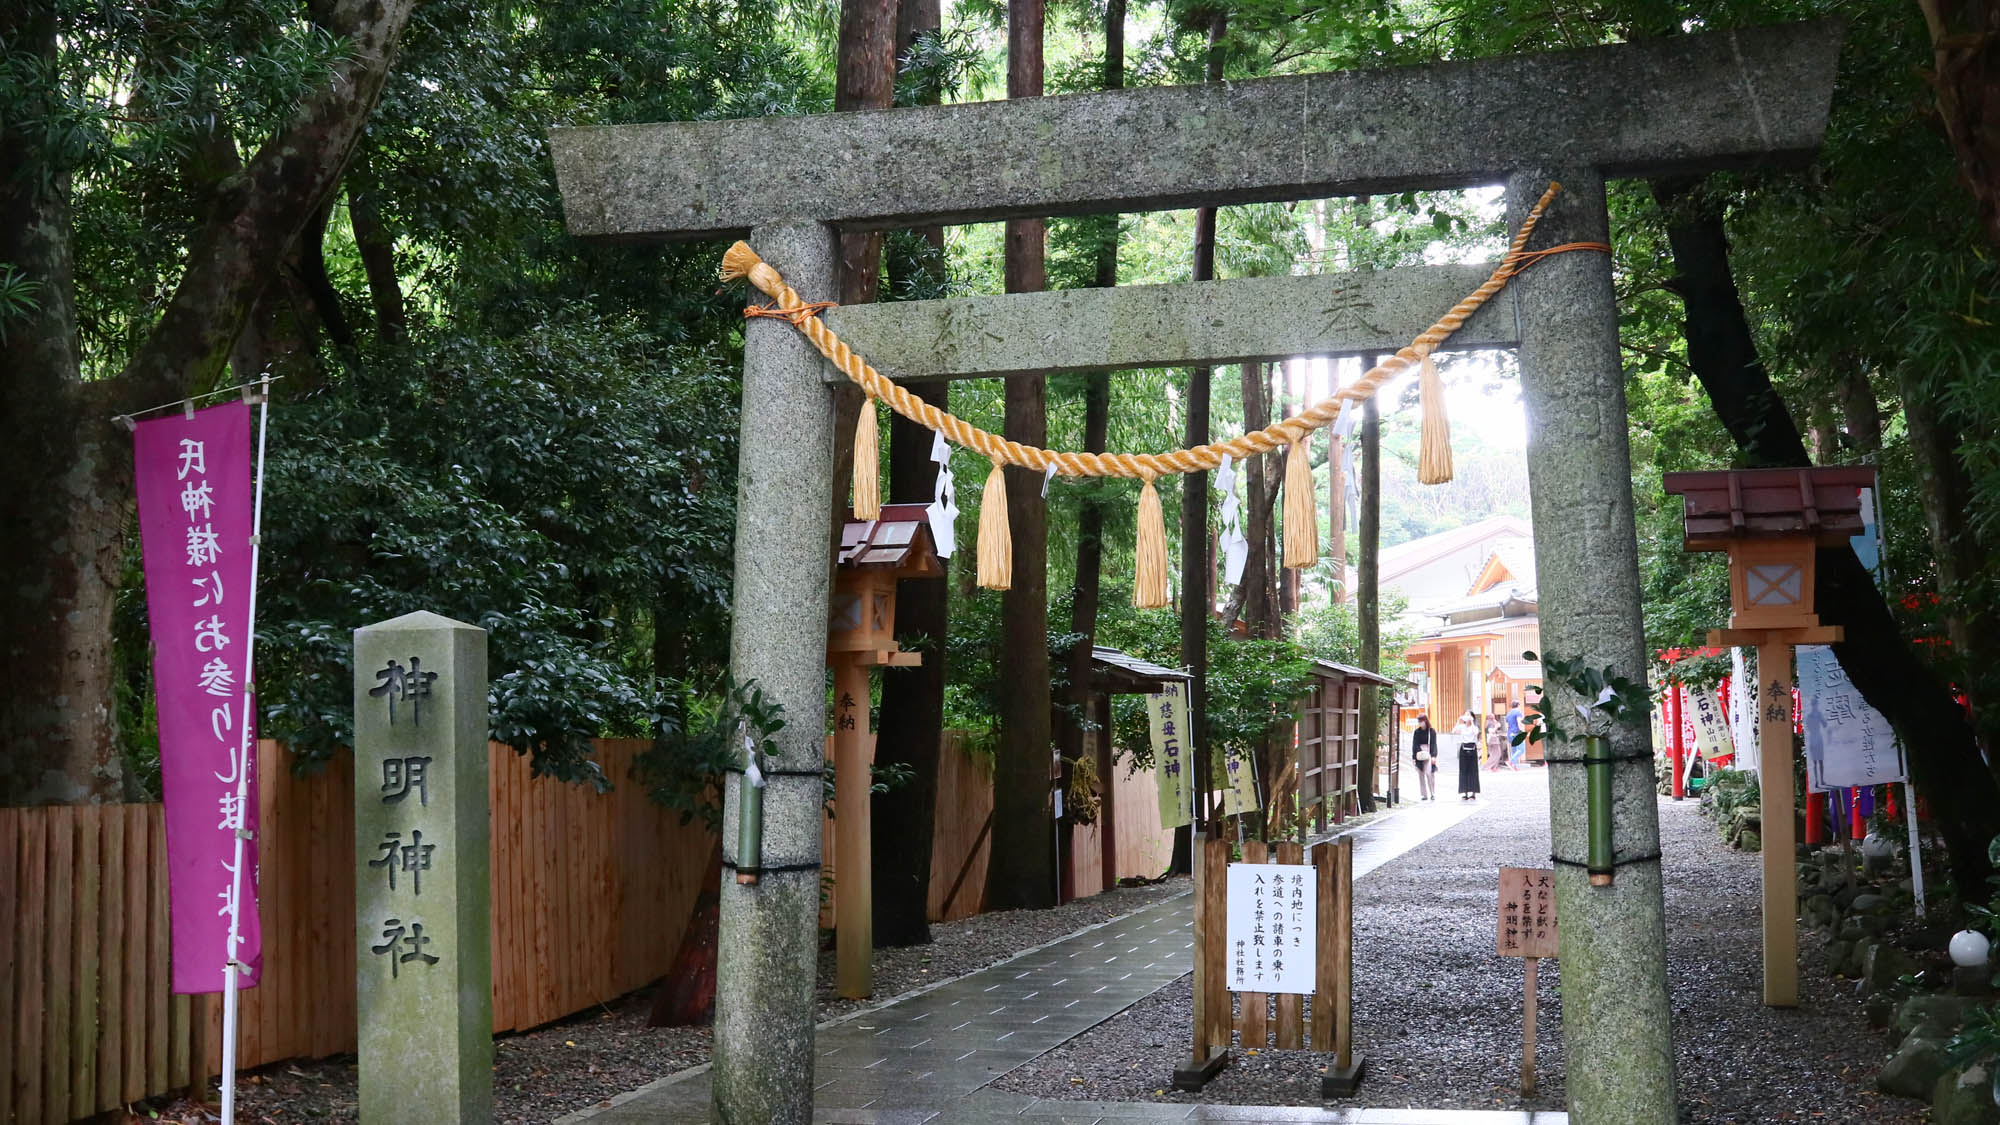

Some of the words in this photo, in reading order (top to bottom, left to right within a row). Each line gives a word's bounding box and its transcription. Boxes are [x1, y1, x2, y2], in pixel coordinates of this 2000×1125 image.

[839, 692, 856, 730] 奉納
[1766, 679, 1787, 723] 奉納
[1160, 701, 1180, 778] 慈母石神
[369, 656, 440, 979] 神明神社
[1253, 874, 1266, 982] 入れを禁止致します
[1272, 874, 1285, 982] 参道への諸車の乗り
[1291, 874, 1304, 948] 境内地につき
[1505, 902, 1519, 949] 神明神社
[1522, 875, 1533, 938] 入るを禁ず
[1236, 940, 1246, 985] 神社社務所
